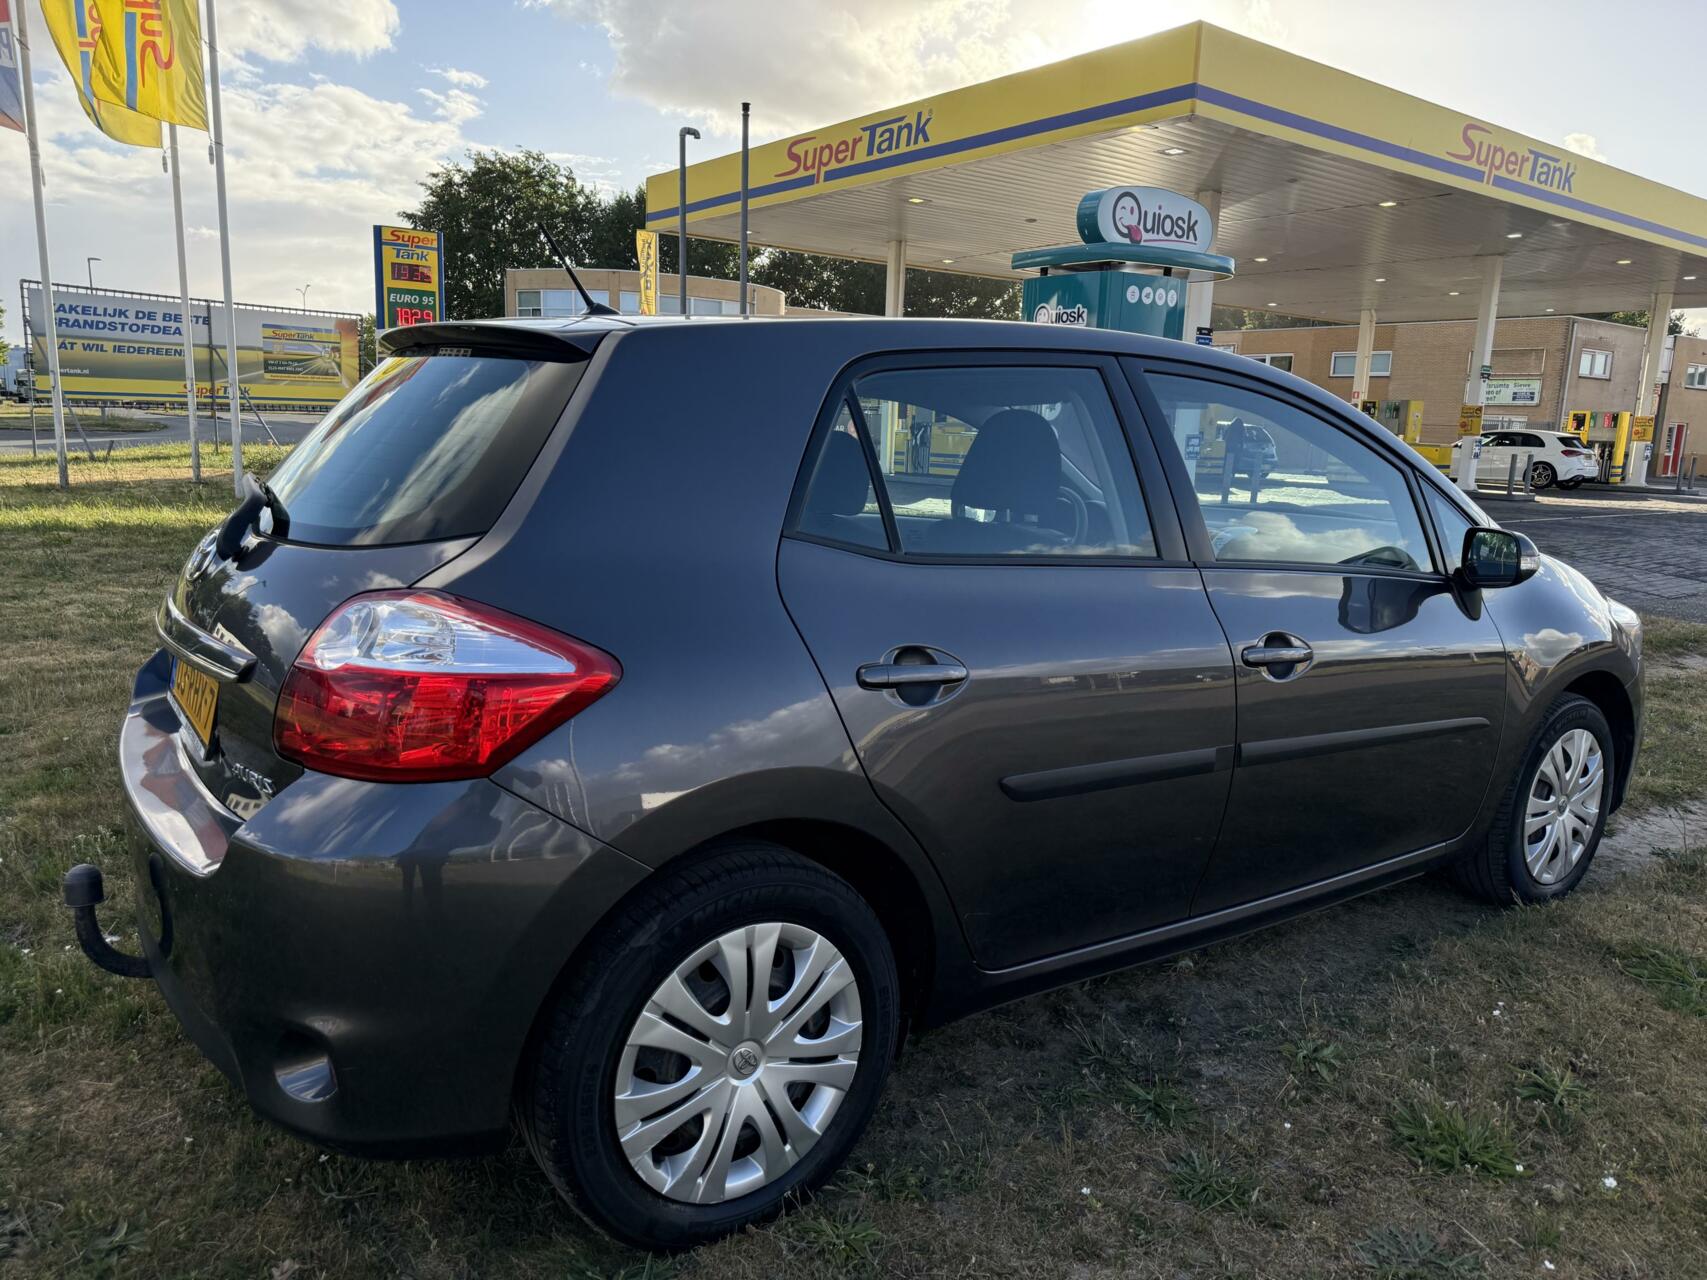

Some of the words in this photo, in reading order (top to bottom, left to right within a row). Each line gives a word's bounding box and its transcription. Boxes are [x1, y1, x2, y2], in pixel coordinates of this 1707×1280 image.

[774, 111, 933, 184] SuperTank
[1446, 123, 1577, 193] SuperTank
[1112, 191, 1198, 244] Quiosk
[383, 229, 437, 248] Super
[392, 248, 429, 261] Tank
[389, 293, 419, 304] EURO
[422, 296, 434, 305] 95
[54, 303, 130, 319] AKELIJK
[135, 310, 157, 321] DE
[162, 312, 209, 326] BETE
[54, 317, 183, 336] RANDSTOFDEA
[82, 342, 108, 353] WIL
